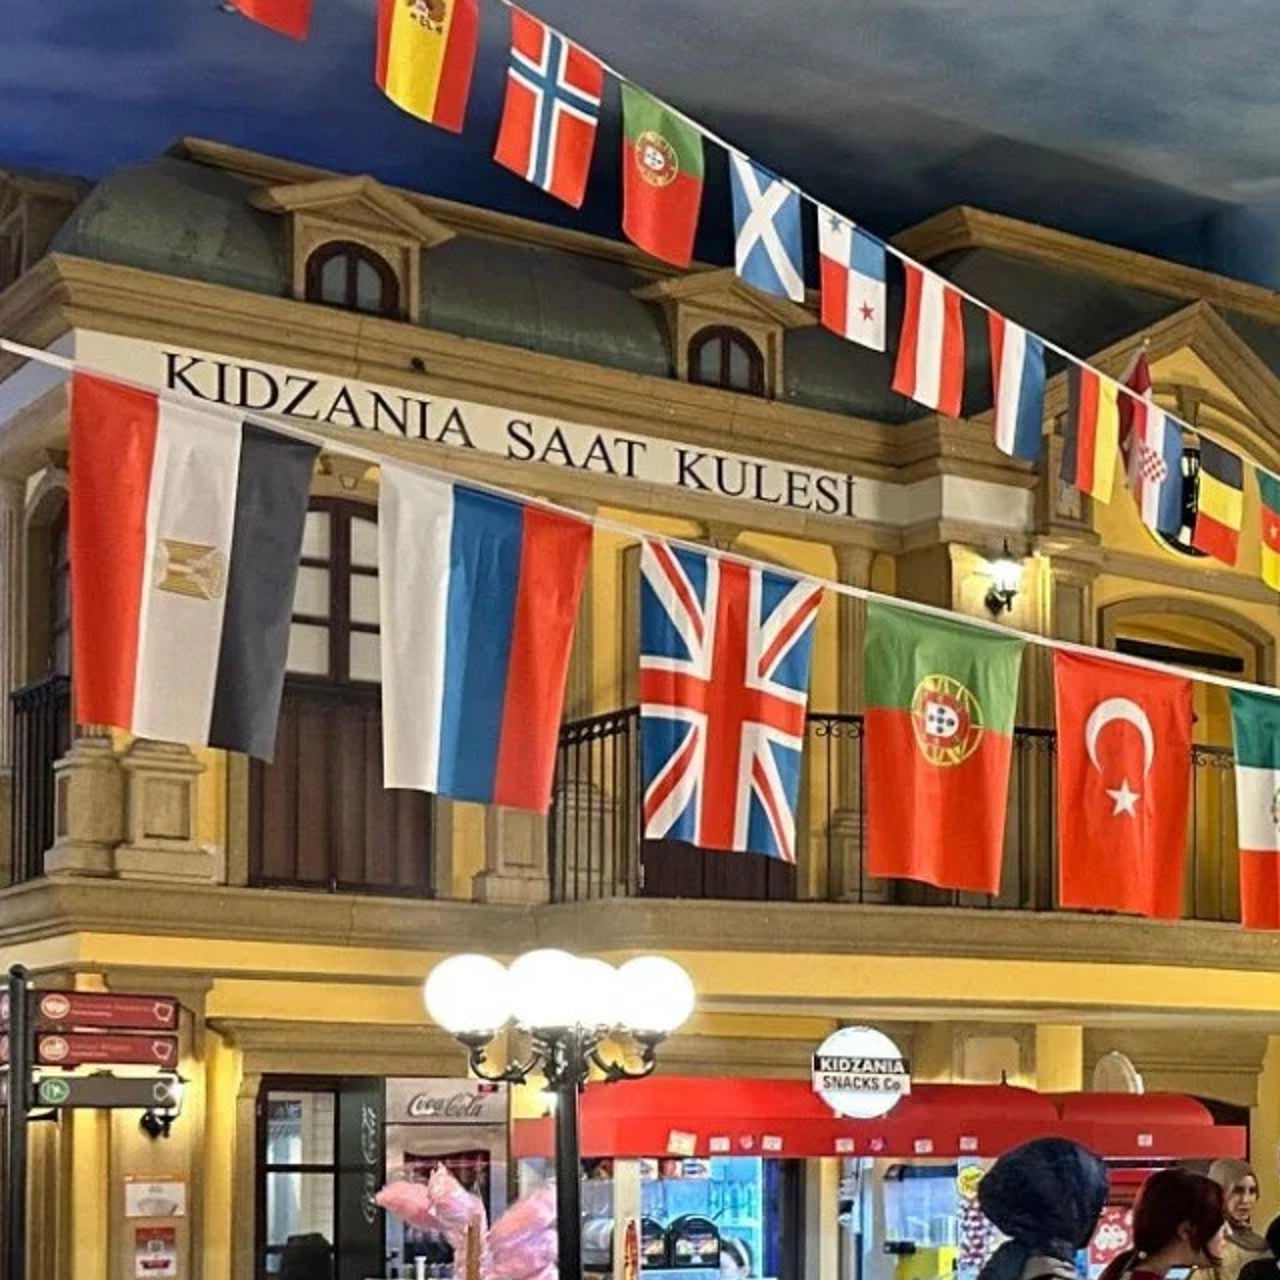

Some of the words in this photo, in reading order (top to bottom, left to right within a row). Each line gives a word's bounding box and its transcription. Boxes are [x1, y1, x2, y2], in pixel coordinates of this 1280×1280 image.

[162, 351, 476, 449] KIDZANIA
[505, 418, 647, 478] SAAT
[674, 448, 858, 517] KULESİ
[820, 1057, 905, 1073] KIDZANIA
[823, 1075, 880, 1090] SNACKS
